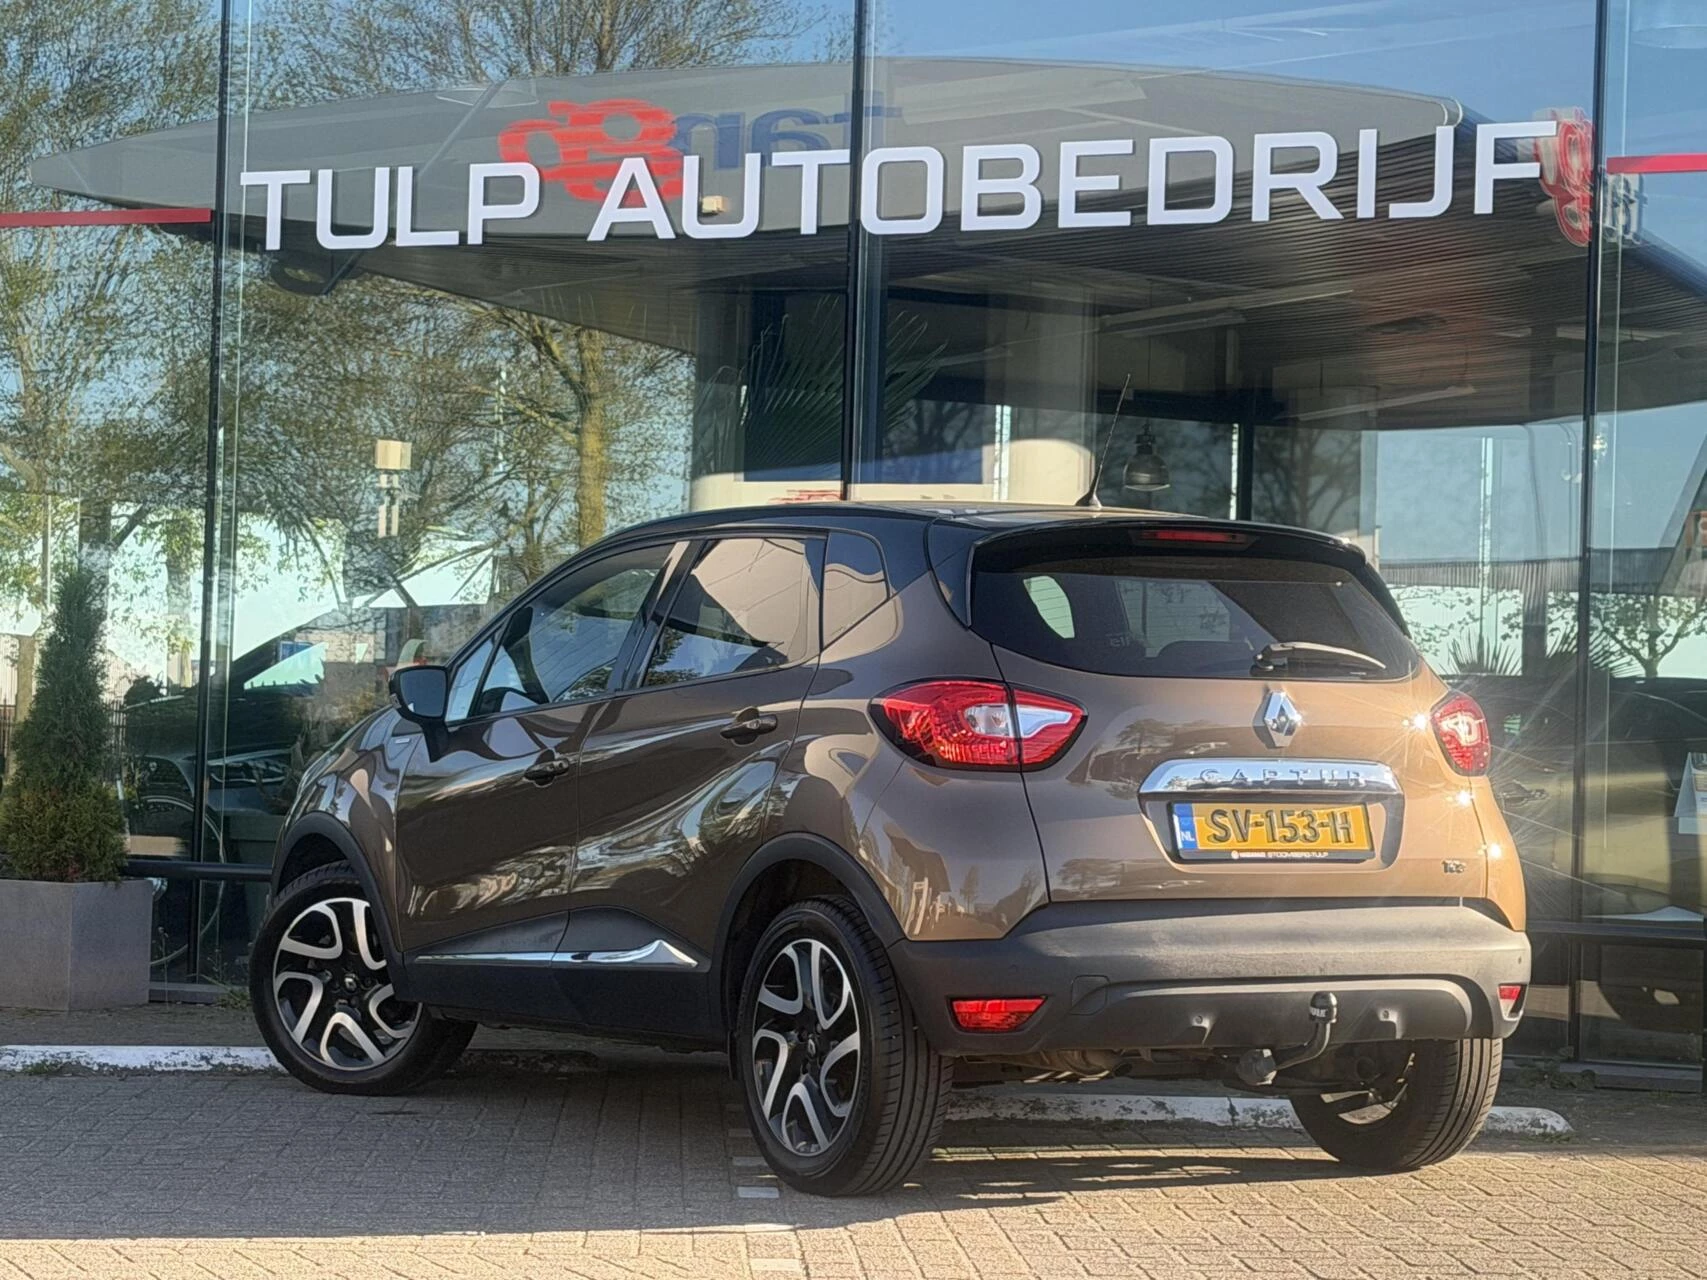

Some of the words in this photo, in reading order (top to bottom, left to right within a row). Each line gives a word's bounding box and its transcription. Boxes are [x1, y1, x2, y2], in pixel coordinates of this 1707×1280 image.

[240, 162, 540, 250] TULP
[588, 120, 1557, 245] AUTOBEDRIJF
[1200, 768, 1367, 787] CAPTUR
[1181, 831, 1196, 842] NL
[1208, 808, 1354, 843] SV-153-H
